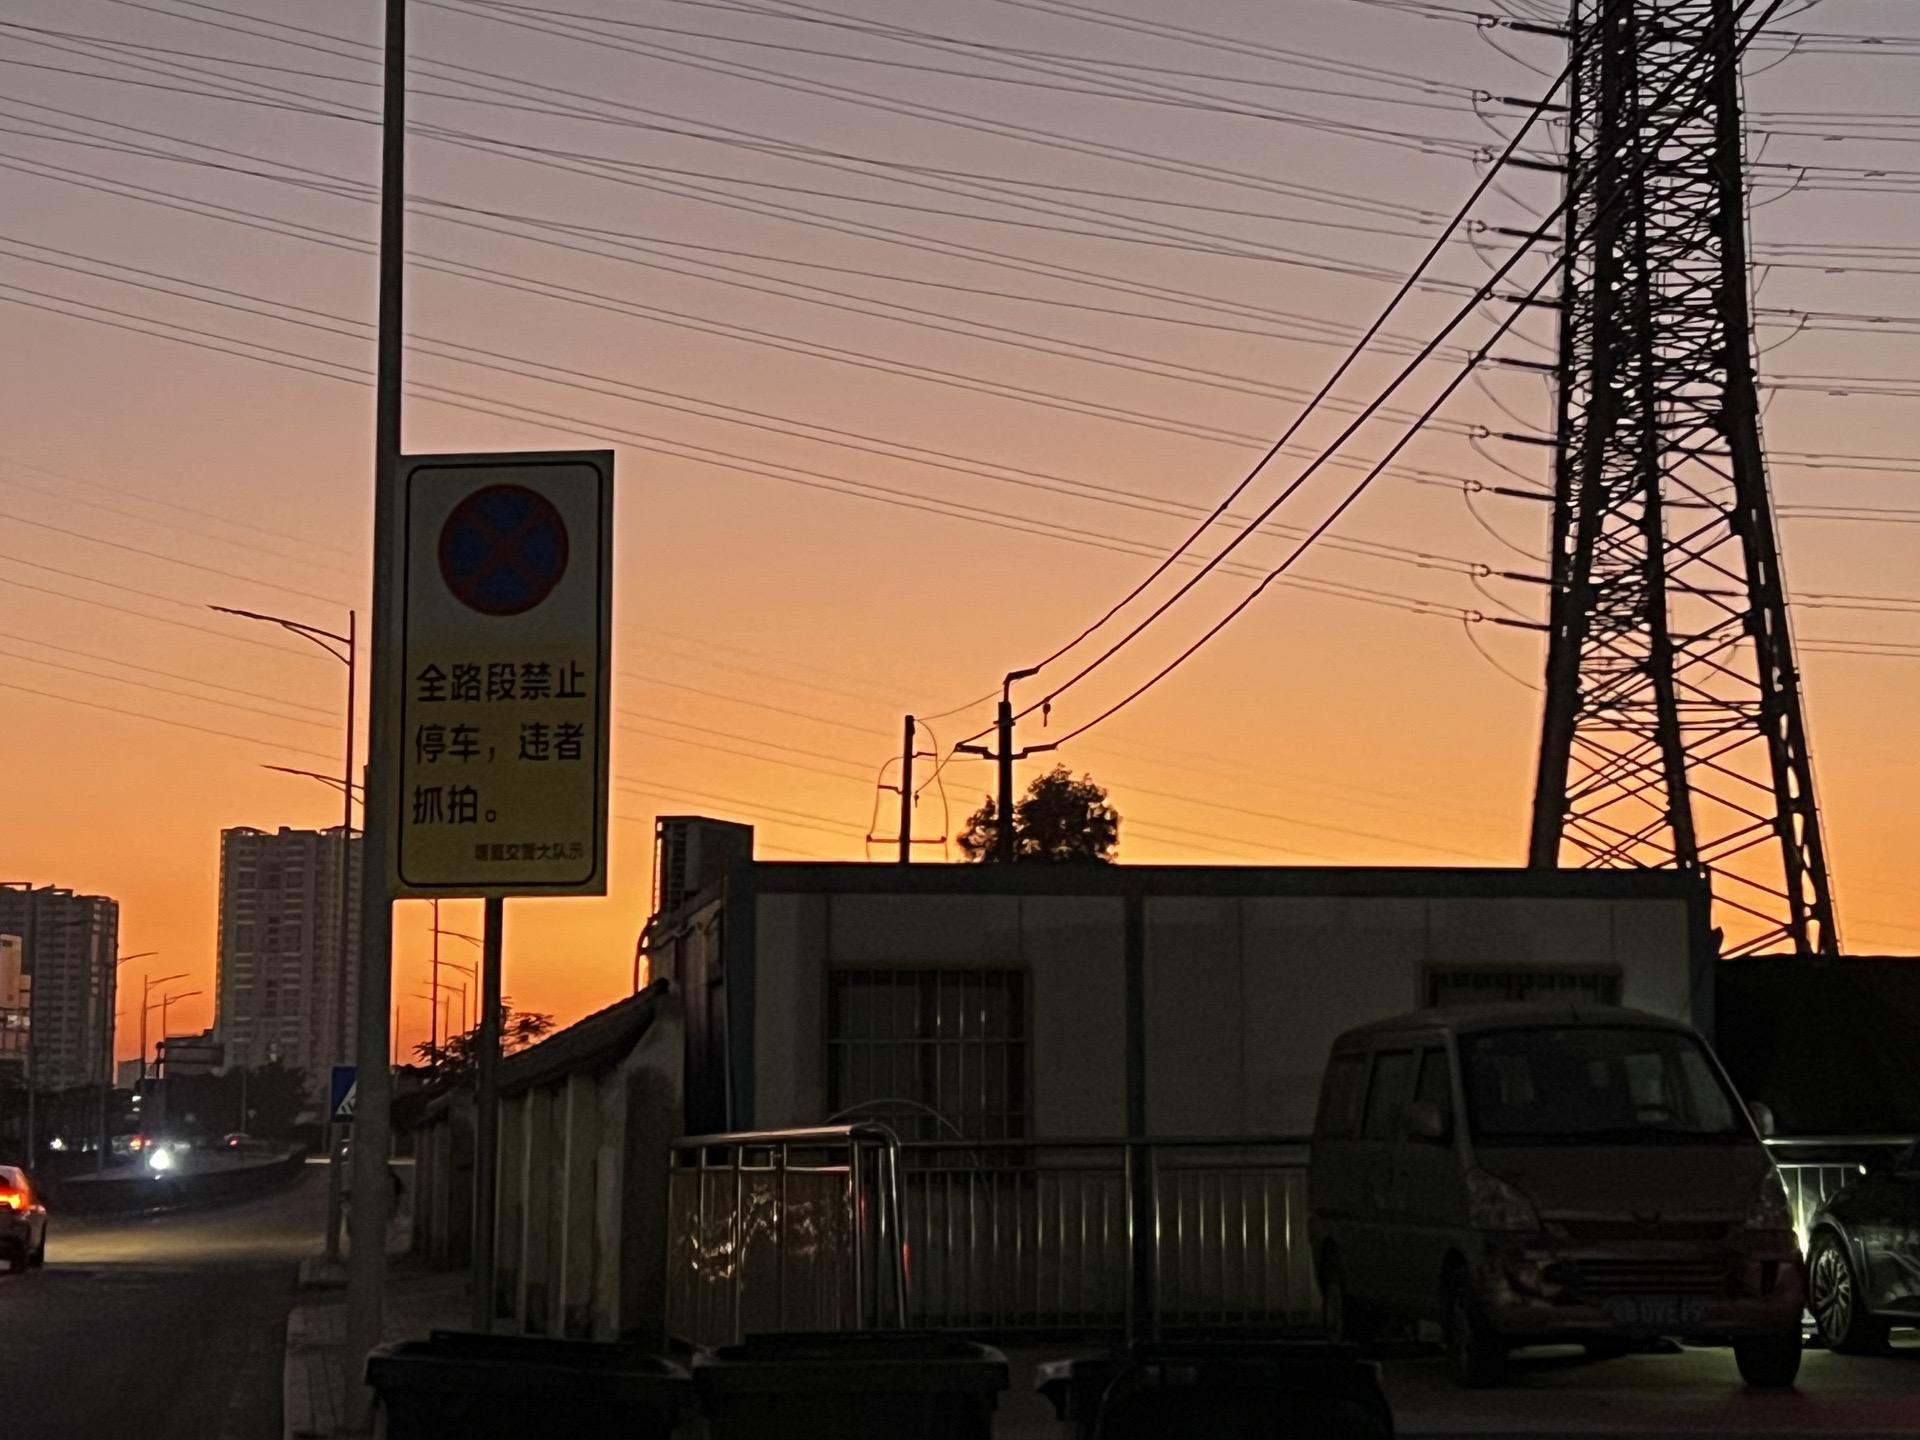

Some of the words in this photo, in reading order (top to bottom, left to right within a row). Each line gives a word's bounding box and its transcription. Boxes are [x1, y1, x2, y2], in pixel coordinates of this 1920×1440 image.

[416, 660, 587, 703] 全路段禁止
[415, 721, 584, 765] 停车，违者
[412, 783, 497, 826] 抓拍。
